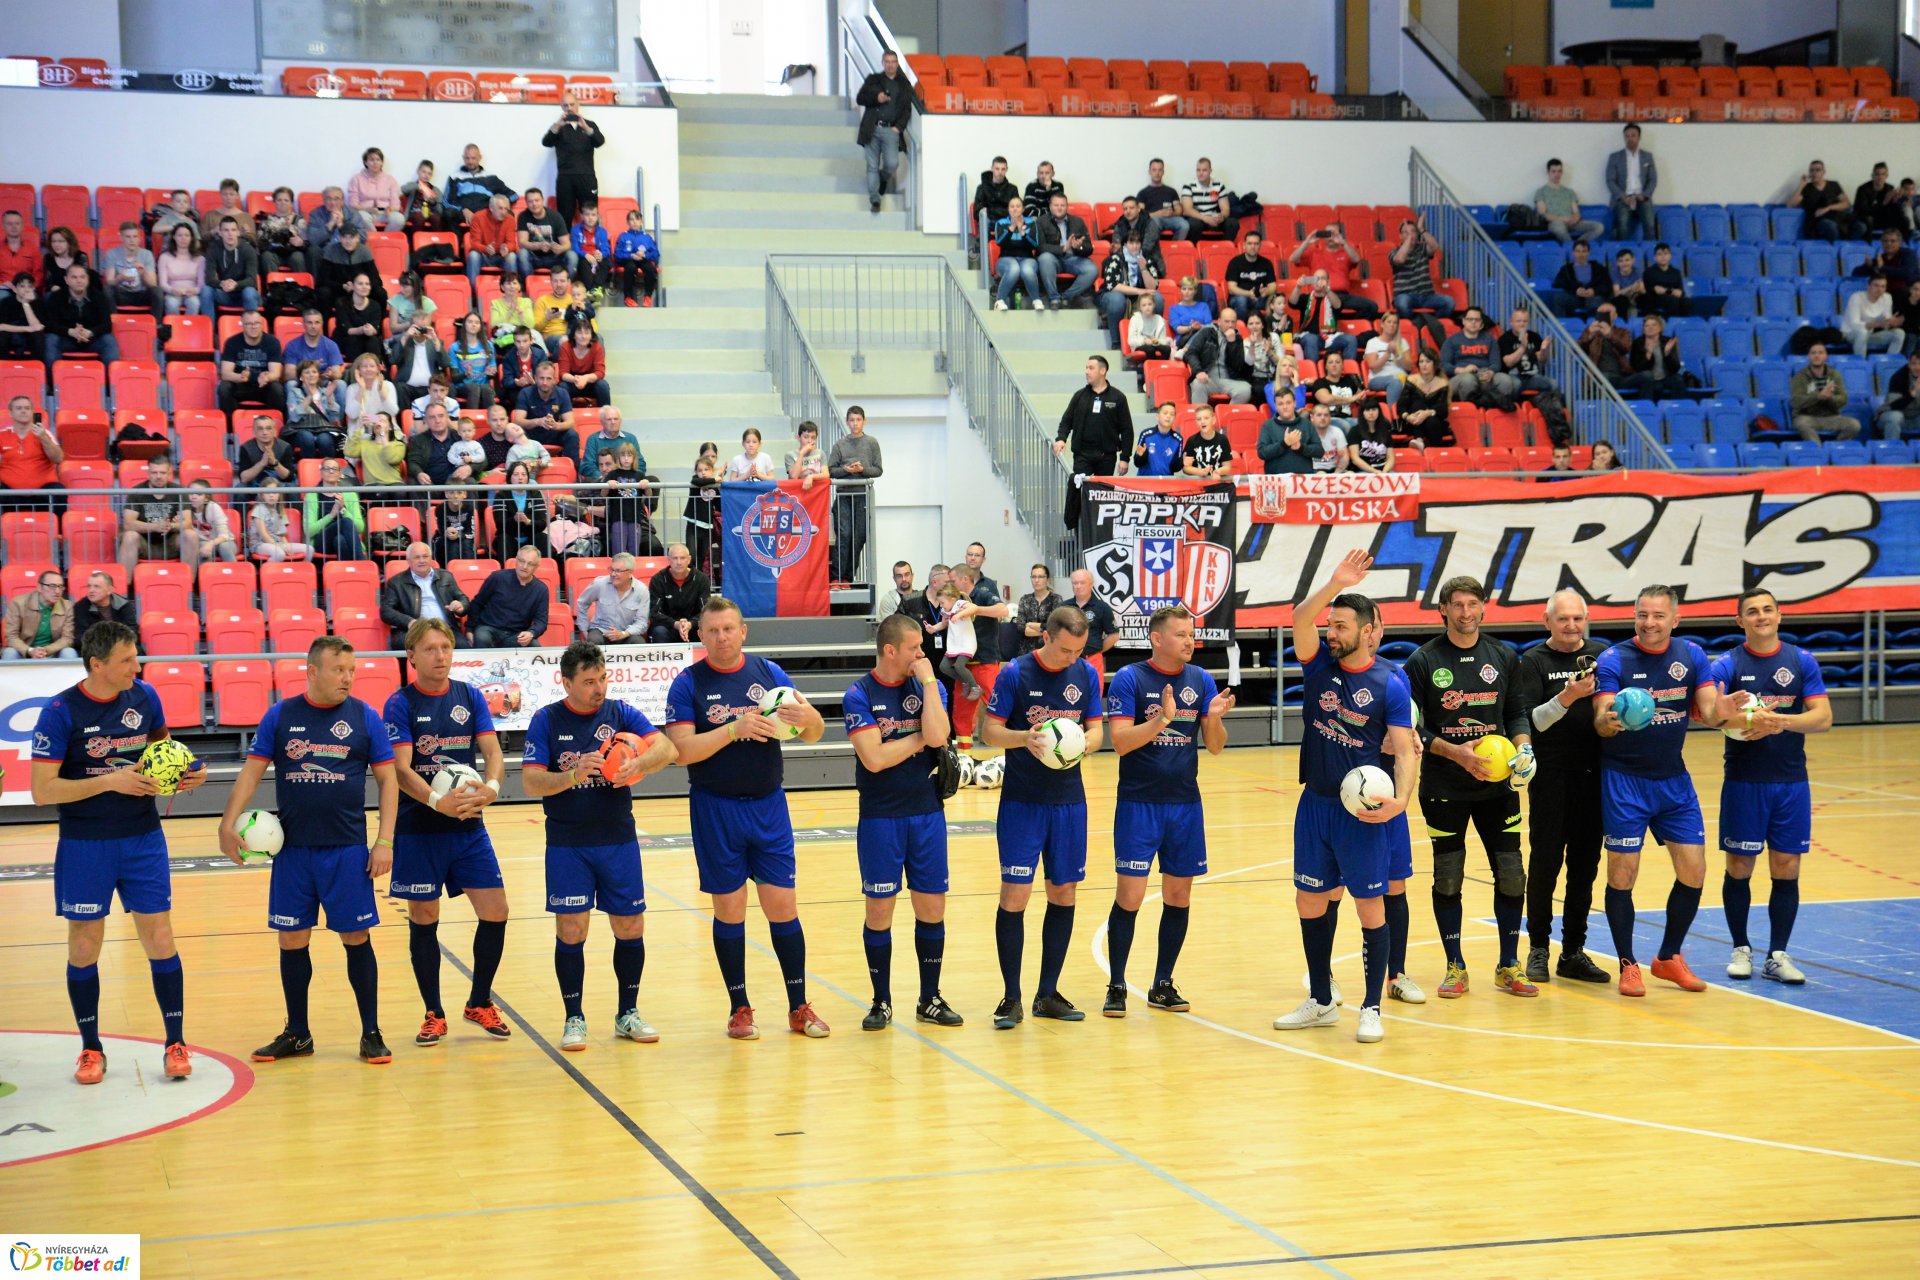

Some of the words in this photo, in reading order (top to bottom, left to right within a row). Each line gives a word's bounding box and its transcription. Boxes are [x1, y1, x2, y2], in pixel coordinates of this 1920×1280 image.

[444, 81, 470, 96] BH
[1164, 495, 1178, 504] DO
[1305, 499, 1401, 522] POLSKA
[761, 514, 776, 529] NY
[1096, 504, 1223, 532] PAPKA
[1135, 528, 1182, 538] RESOVIA
[1142, 600, 1174, 611] 1905
[1194, 628, 1230, 641] RAZEM
[84, 726, 101, 734] JAKO
[78, 1016, 96, 1024] JAKO
